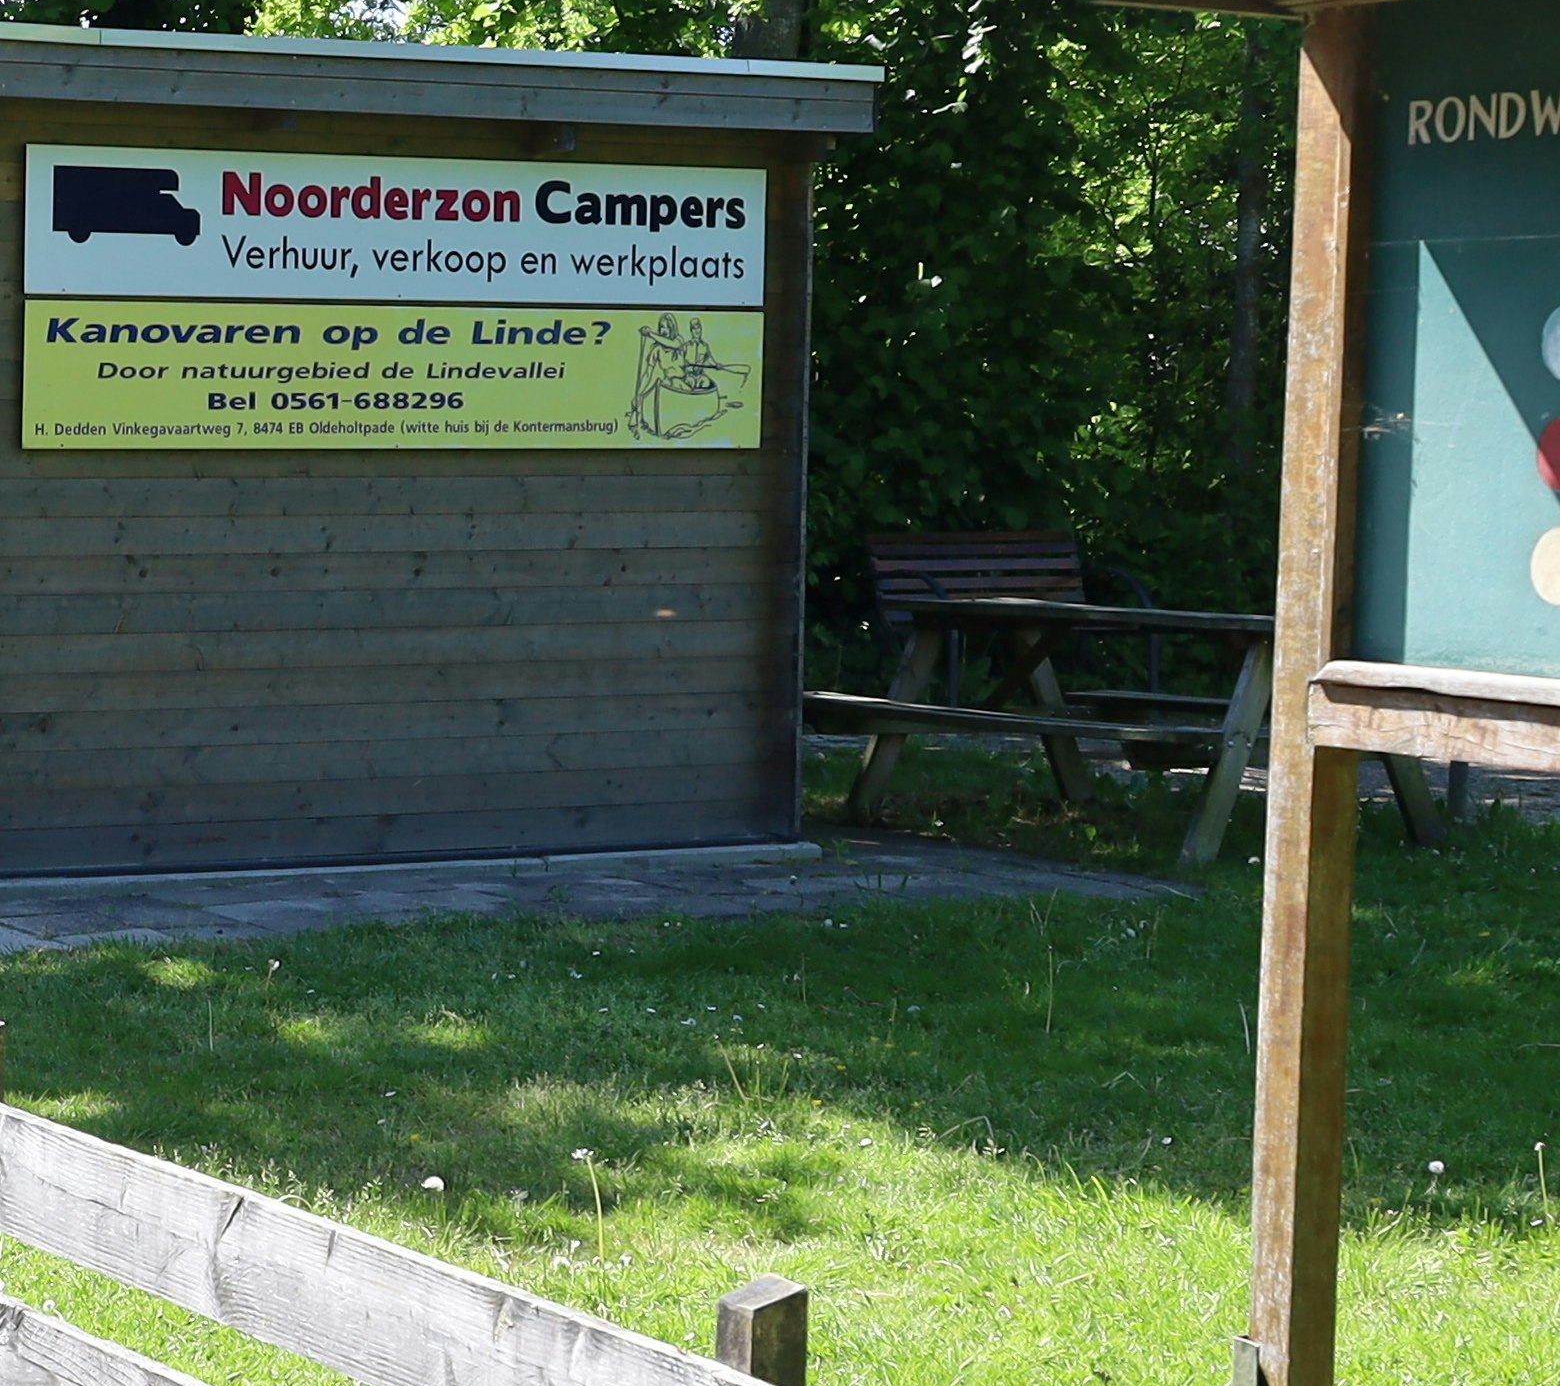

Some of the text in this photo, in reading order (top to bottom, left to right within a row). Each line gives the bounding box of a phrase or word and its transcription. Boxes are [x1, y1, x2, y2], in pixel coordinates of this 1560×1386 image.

[221, 171, 746, 233] Noorderzon Campers
[221, 234, 745, 286] Verhuur, verkoop en werkplaats
[45, 317, 612, 351] Kanovaren op de Linde?
[96, 361, 566, 384] Door natuurgebied de Lindevallei
[207, 391, 464, 411] Bel 0561-688296
[34, 420, 619, 439] H. Dedden Vinkegavaartweg 7, 8474 EB Oldeholtpade (witte huis bij de Kontermansbrug)
